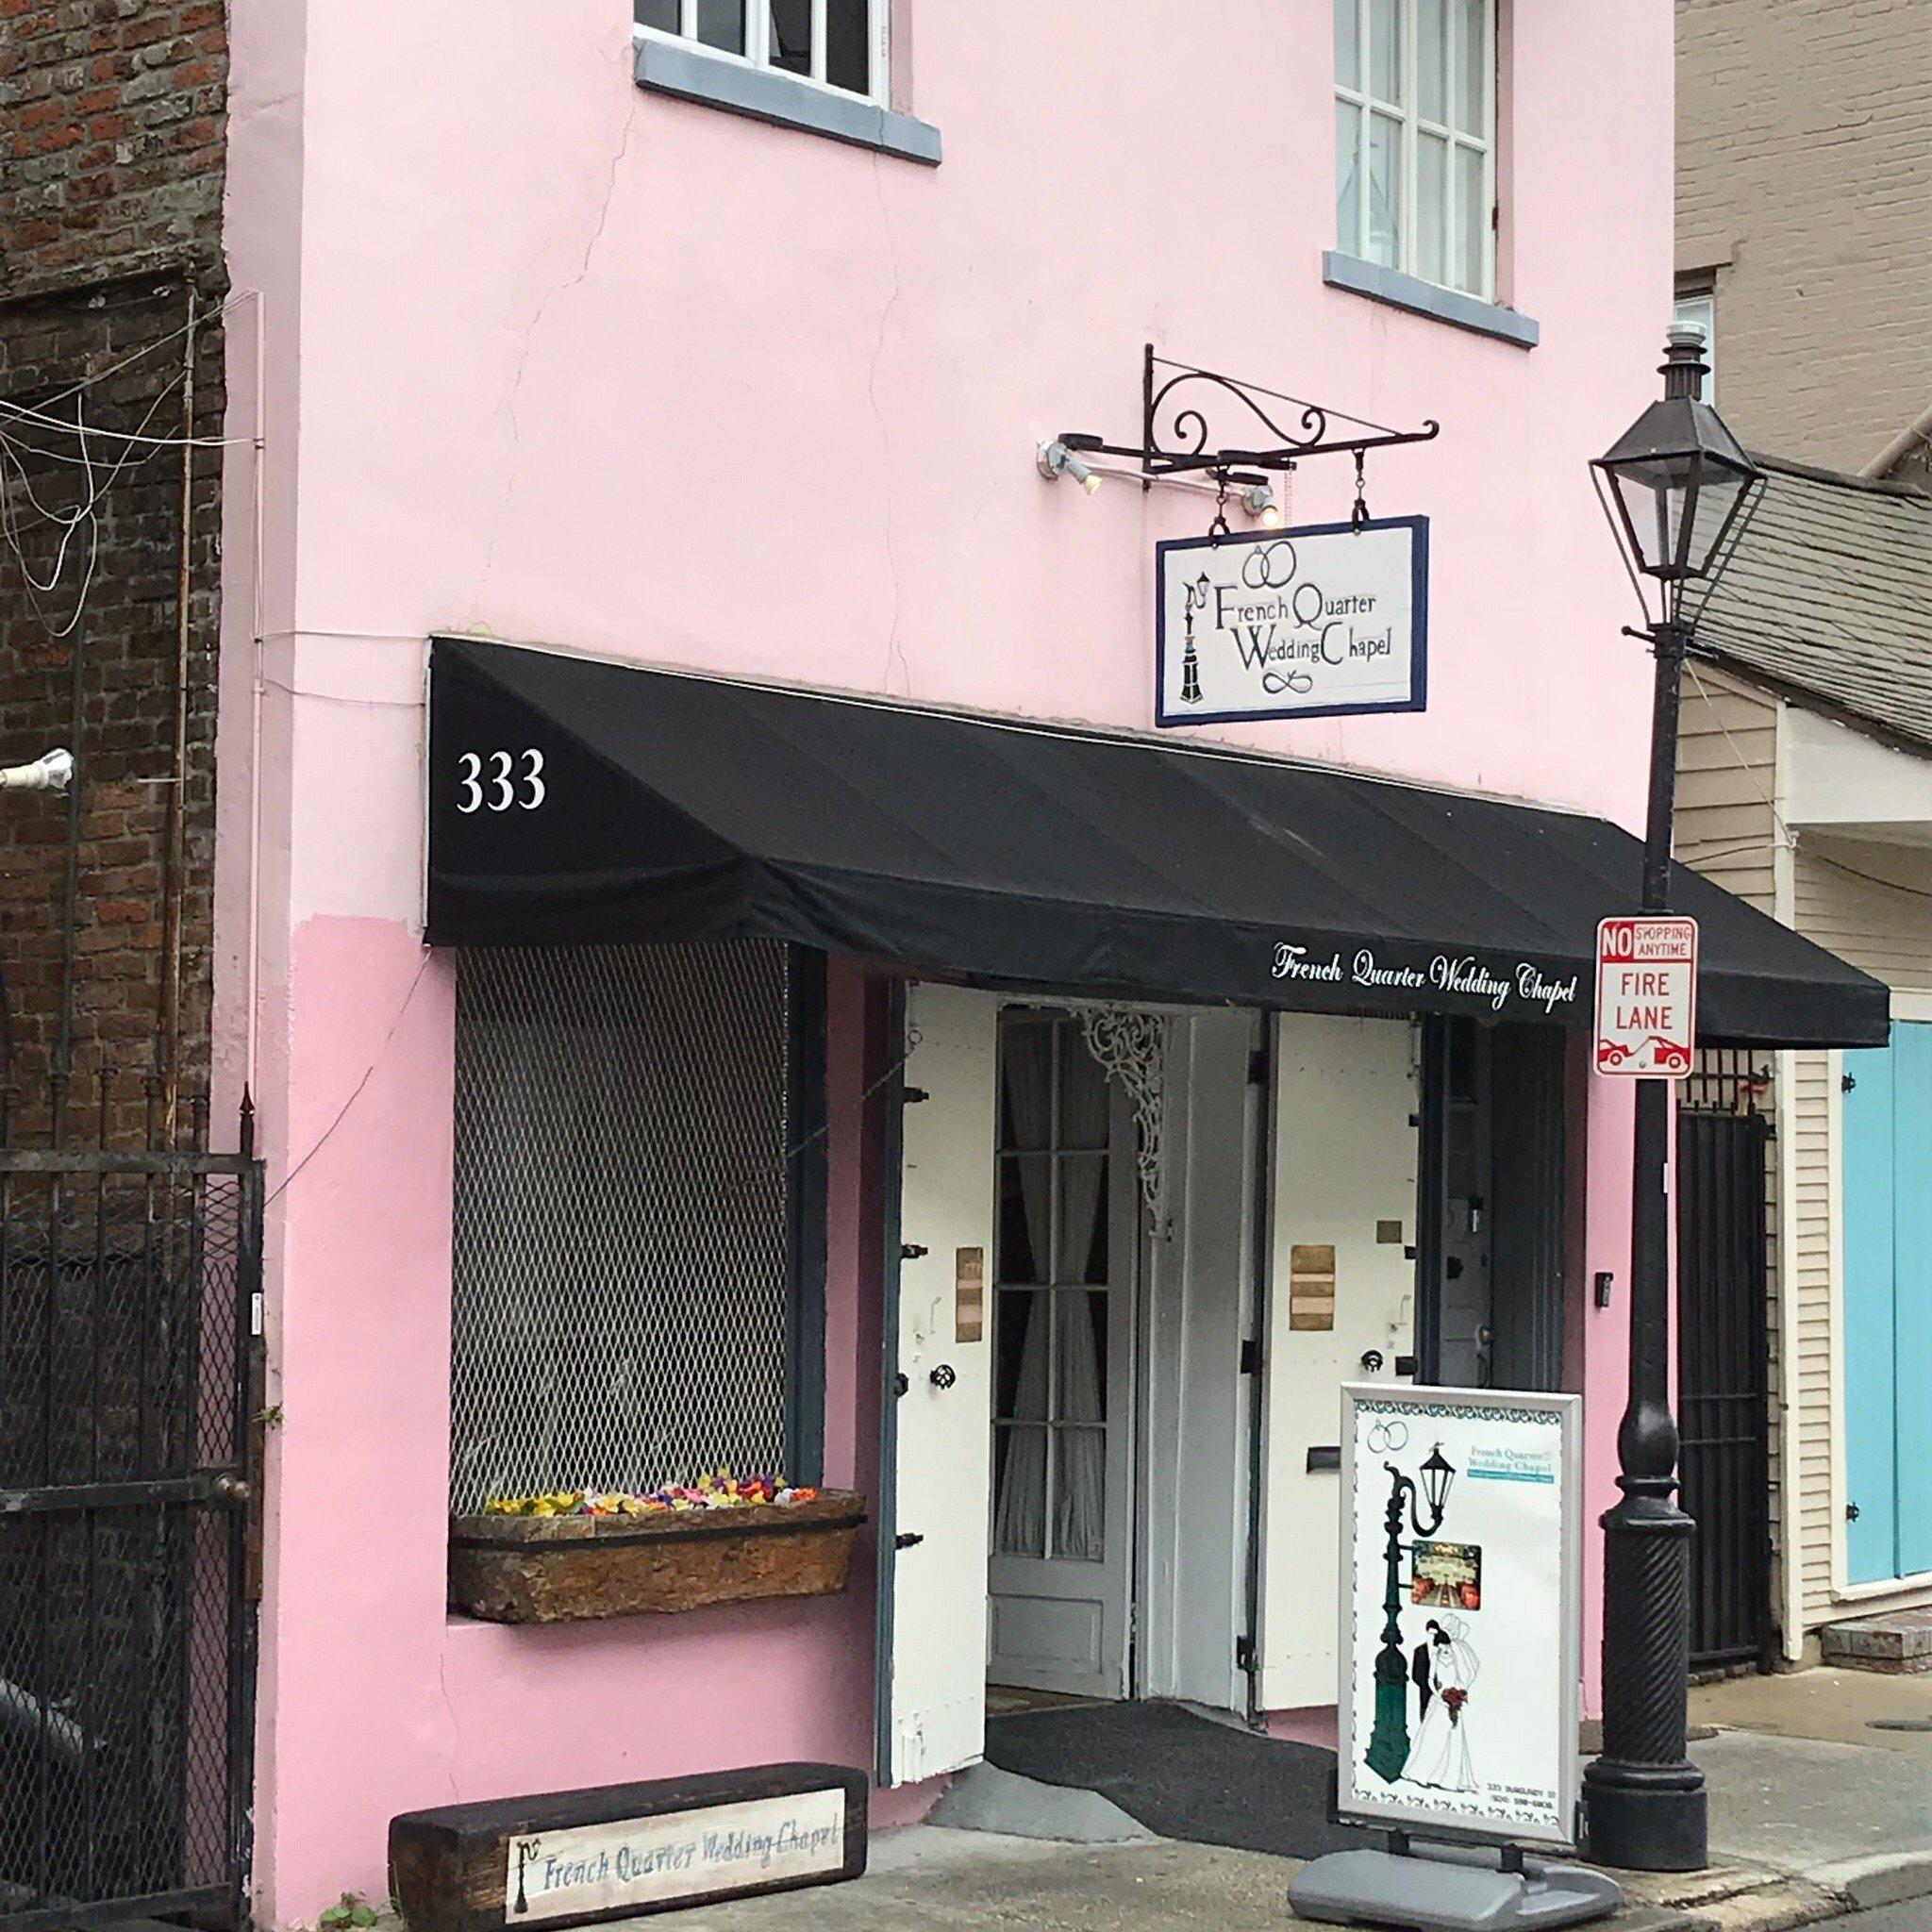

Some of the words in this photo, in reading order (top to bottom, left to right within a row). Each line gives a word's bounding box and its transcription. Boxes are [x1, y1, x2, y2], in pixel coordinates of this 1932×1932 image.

[1214, 586, 1289, 629] French
[1292, 583, 1376, 630] Quarter
[1230, 625, 1320, 671] Wedding
[1321, 622, 1392, 665] Chapel
[457, 748, 545, 813] 333
[1603, 927, 1632, 957] NO
[1638, 942, 1687, 956] ANYTIME
[1271, 941, 1342, 981] French
[1352, 949, 1425, 987] Quarter
[1429, 955, 1511, 1011] Wedding
[1516, 962, 1578, 1014] Chapel
[1621, 973, 1670, 996] FIRE
[1616, 1006, 1674, 1030] LANE
[544, 1847, 610, 1890] French
[616, 1843, 695, 1884] Quarter
[702, 1830, 773, 1869] Wedding
[775, 1812, 838, 1857] Chapel
